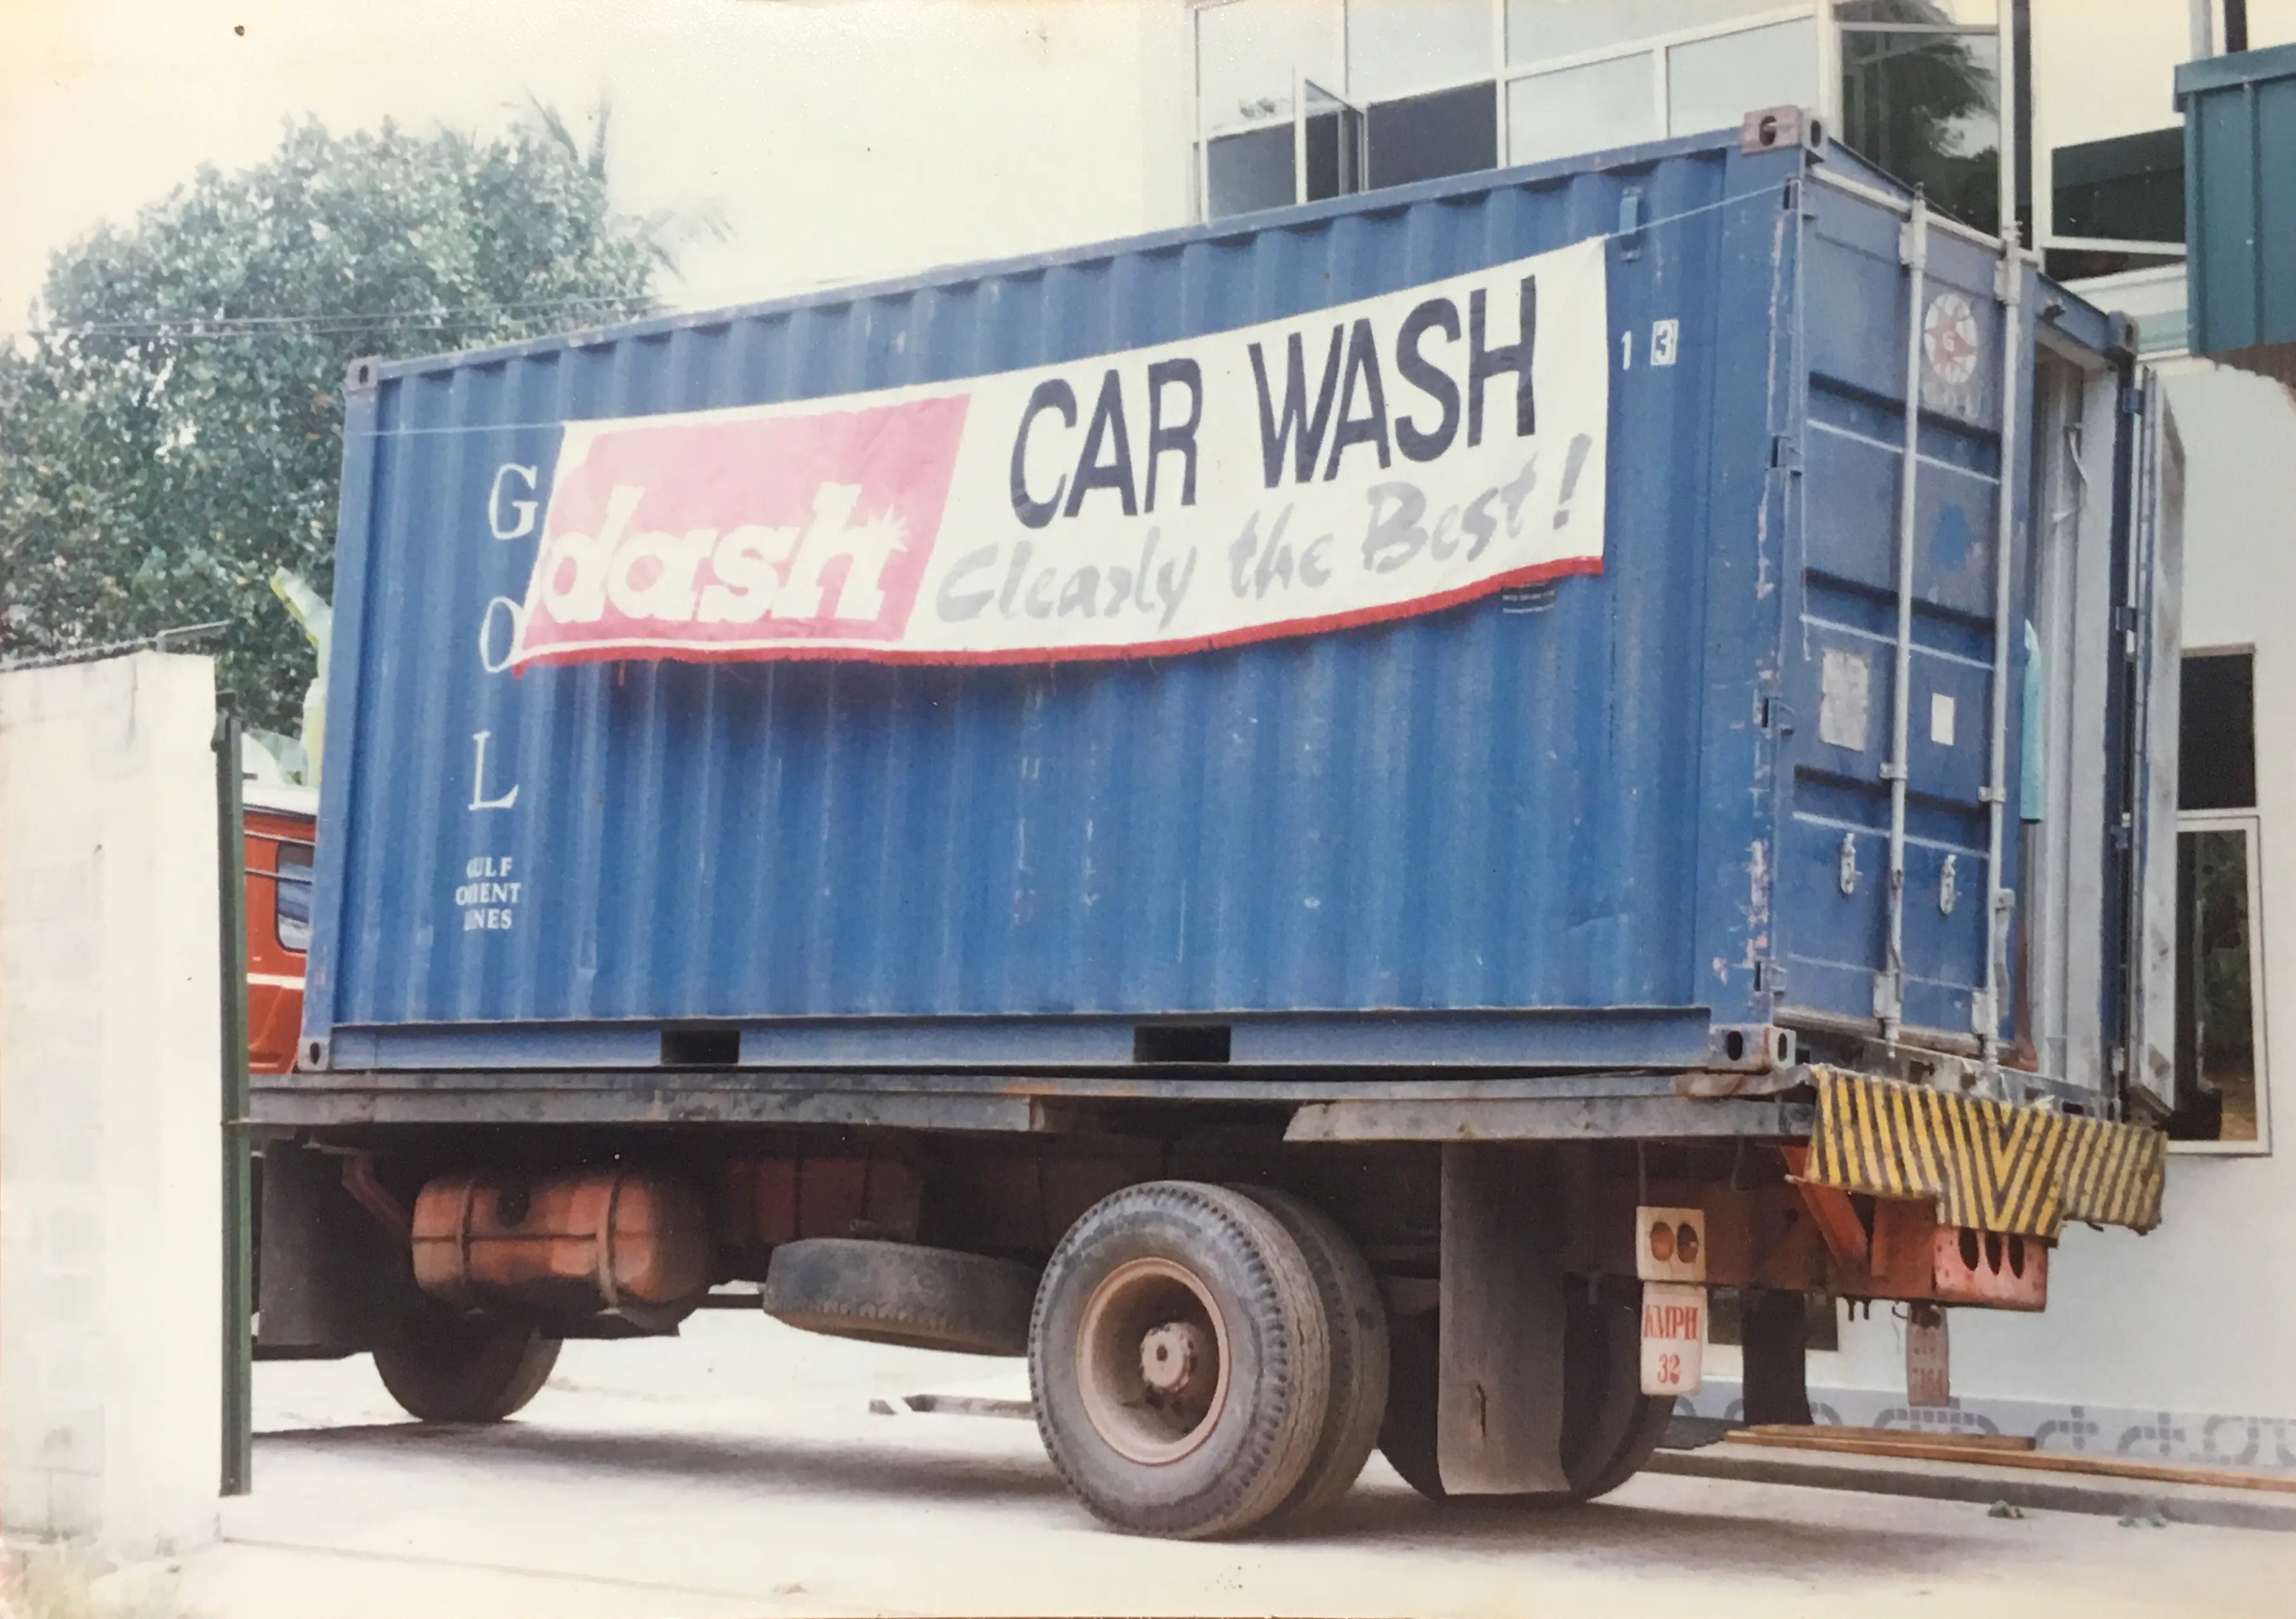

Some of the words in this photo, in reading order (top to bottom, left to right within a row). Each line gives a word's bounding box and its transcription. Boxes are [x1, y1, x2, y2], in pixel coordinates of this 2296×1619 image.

[1010, 358, 1203, 529] CAR
[1247, 274, 1537, 489] WASH
[541, 482, 897, 624] dash
[936, 526, 1198, 631] Clearly
[1228, 502, 1334, 600] the
[1657, 1353, 1680, 1385] 32
